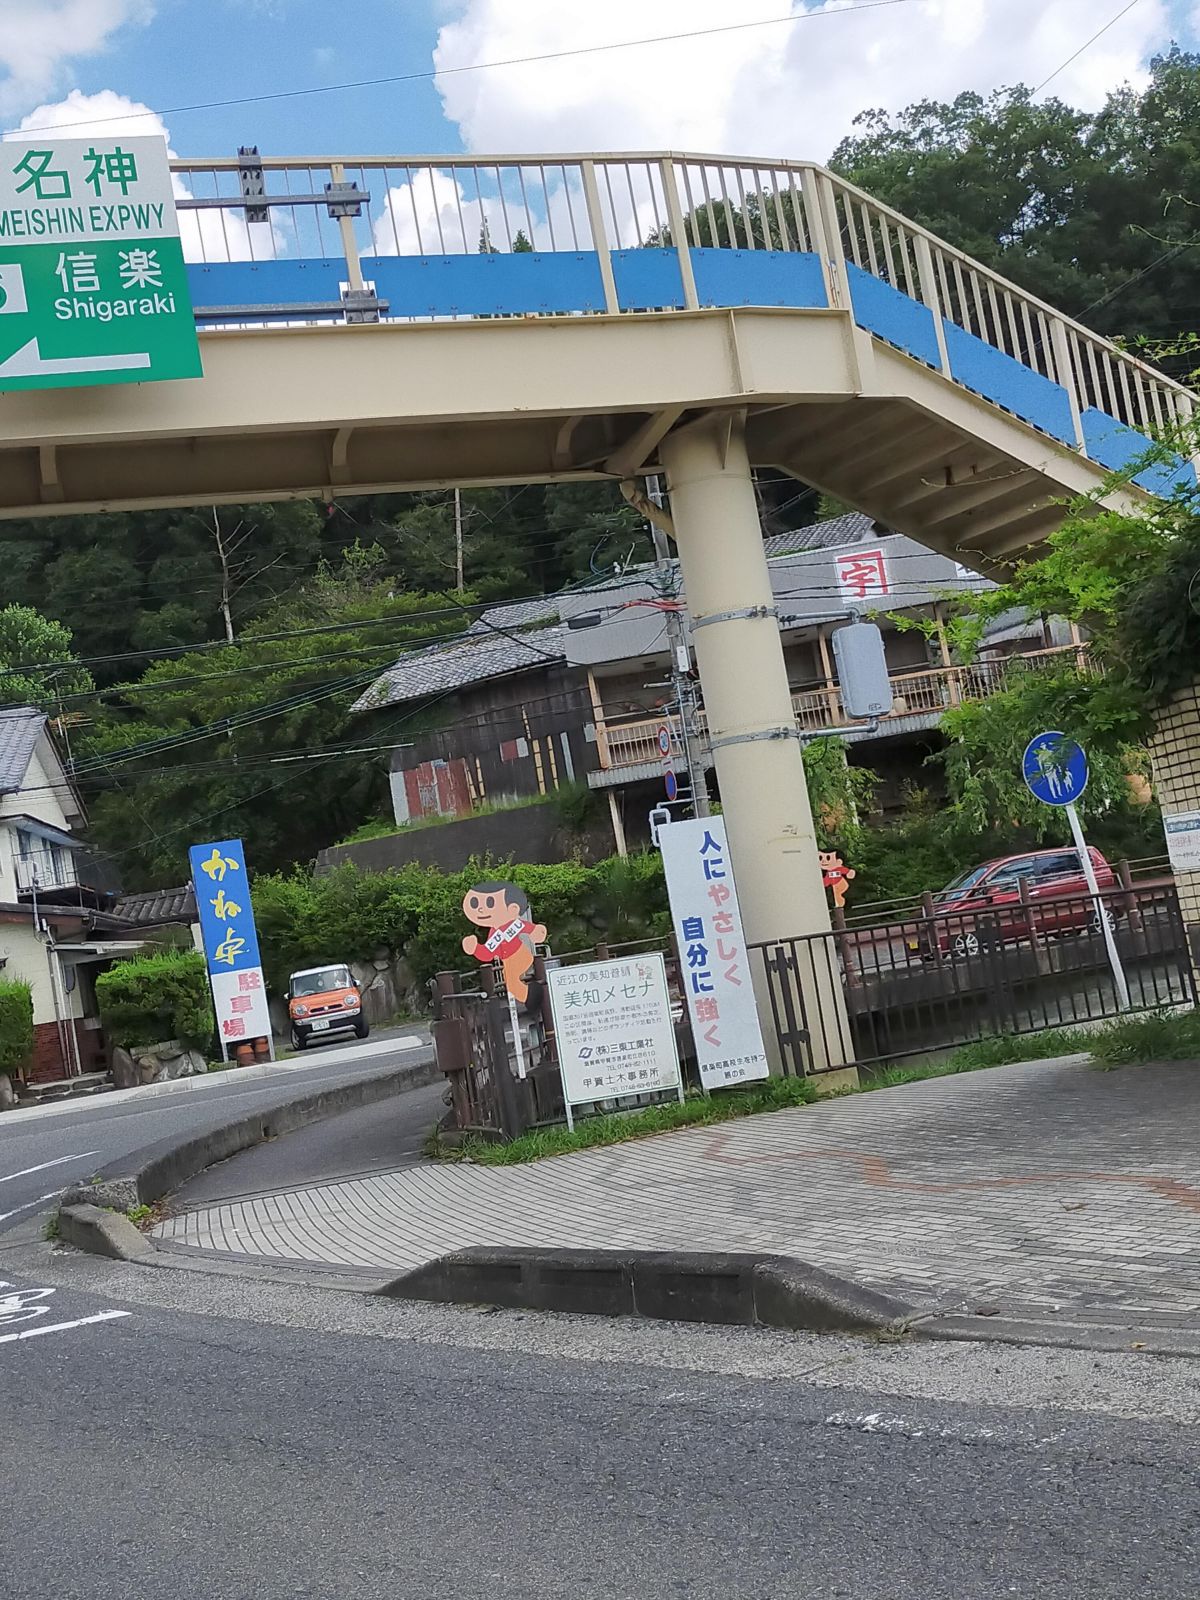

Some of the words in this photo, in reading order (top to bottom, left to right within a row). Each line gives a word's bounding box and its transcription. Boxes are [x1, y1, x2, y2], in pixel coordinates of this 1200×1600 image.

[12, 147, 139, 200] 名神
[90, 203, 165, 232] EXPWY
[55, 248, 164, 293] 信楽
[54, 292, 176, 321] Shigaraki
[699, 830, 743, 987] 人にやさしく
[487, 918, 524, 950] とび出し
[564, 981, 655, 1010] 美知メセナ
[681, 916, 722, 1048] 自分に強く
[222, 972, 261, 1038] 駐車場
